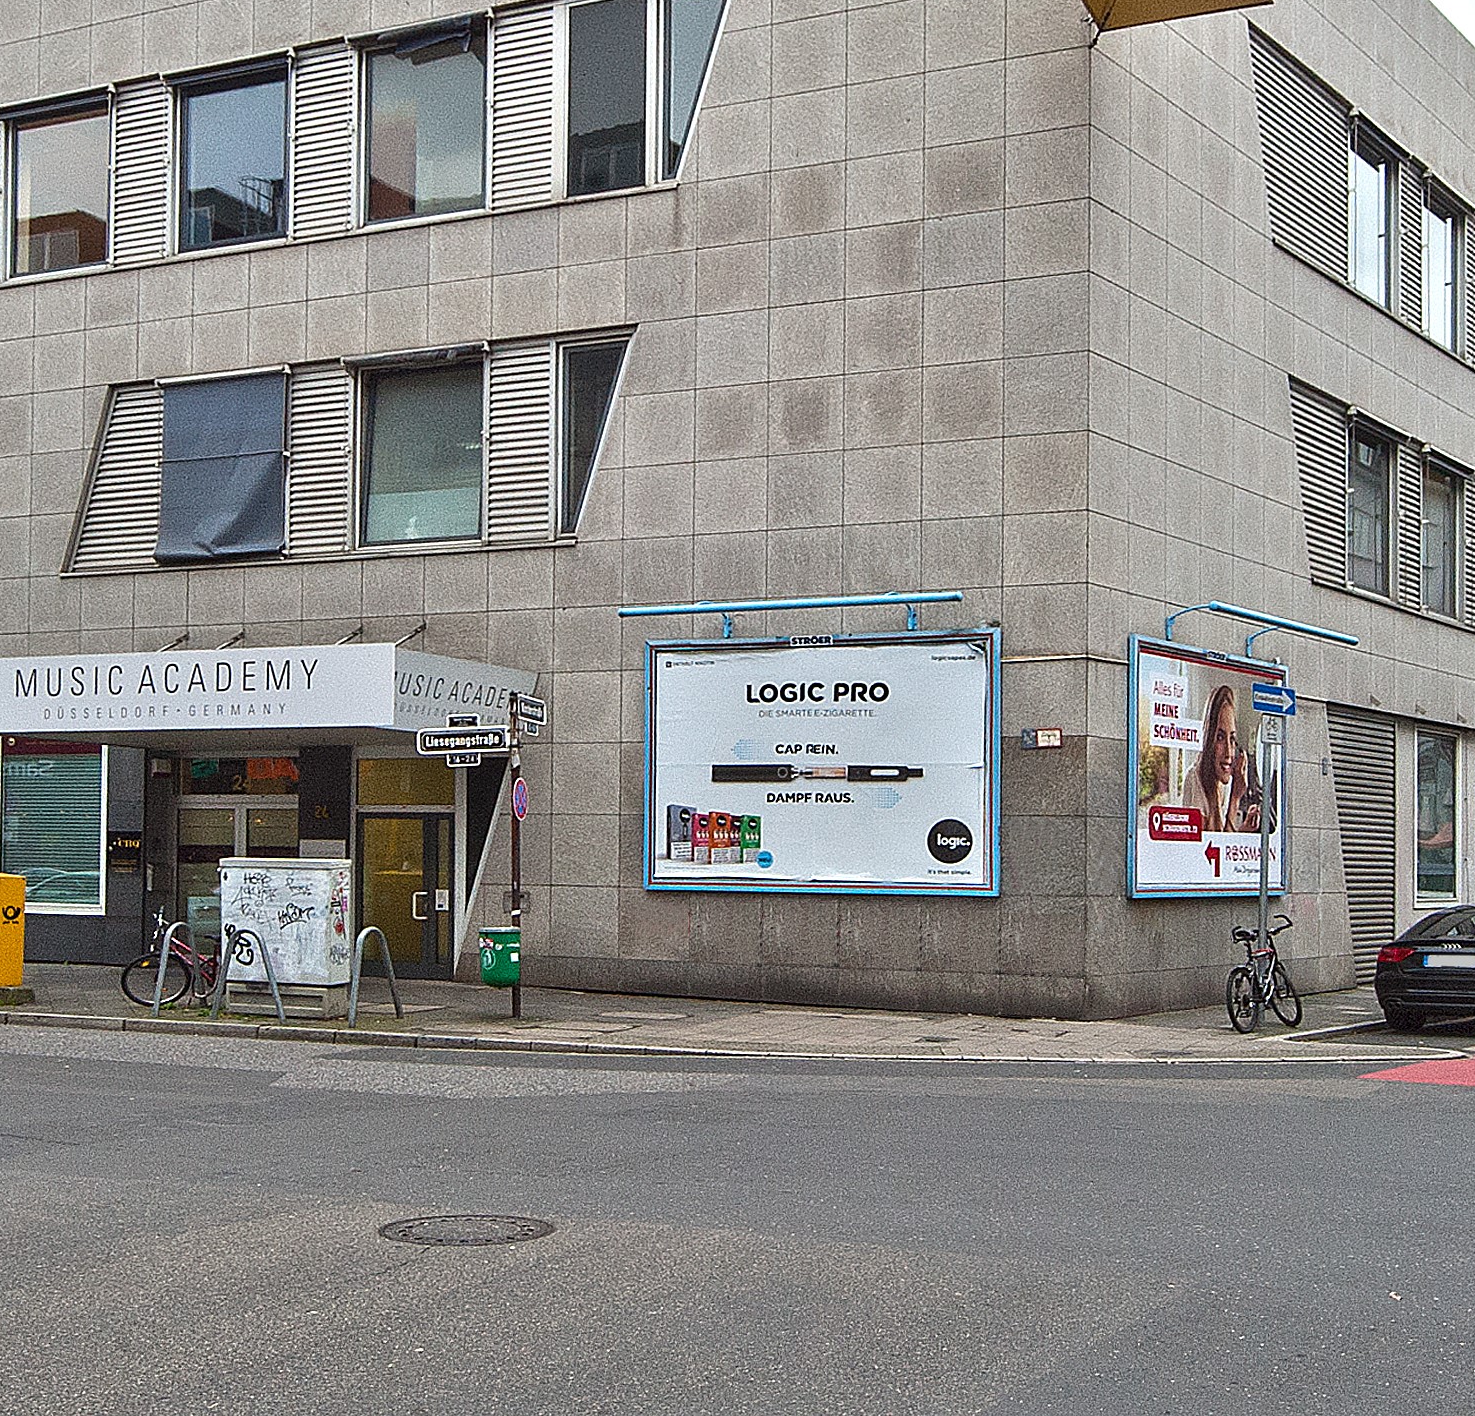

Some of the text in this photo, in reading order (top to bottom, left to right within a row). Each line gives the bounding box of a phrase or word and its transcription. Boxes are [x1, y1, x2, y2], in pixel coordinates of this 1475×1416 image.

[791, 636, 832, 645] STRÖER
[15, 659, 319, 697] MUSIC ACADEMY
[394, 670, 445, 700] USIC
[746, 683, 890, 703] LOGIC PRO
[1152, 680, 1184, 698] Alles für
[43, 703, 287, 720] DÜSSELDORF GERMANY
[758, 710, 773, 718] DIE
[813, 709, 877, 717] E-ZIGARETTE.
[1153, 702, 1179, 719] MEINE
[425, 733, 500, 748] Liesegangstraße
[1153, 723, 1200, 743] SCHÖNHEIT.
[775, 744, 839, 754] CAP REIN.
[766, 793, 855, 803] DAMPF RAUS.
[937, 833, 971, 850] logic.
